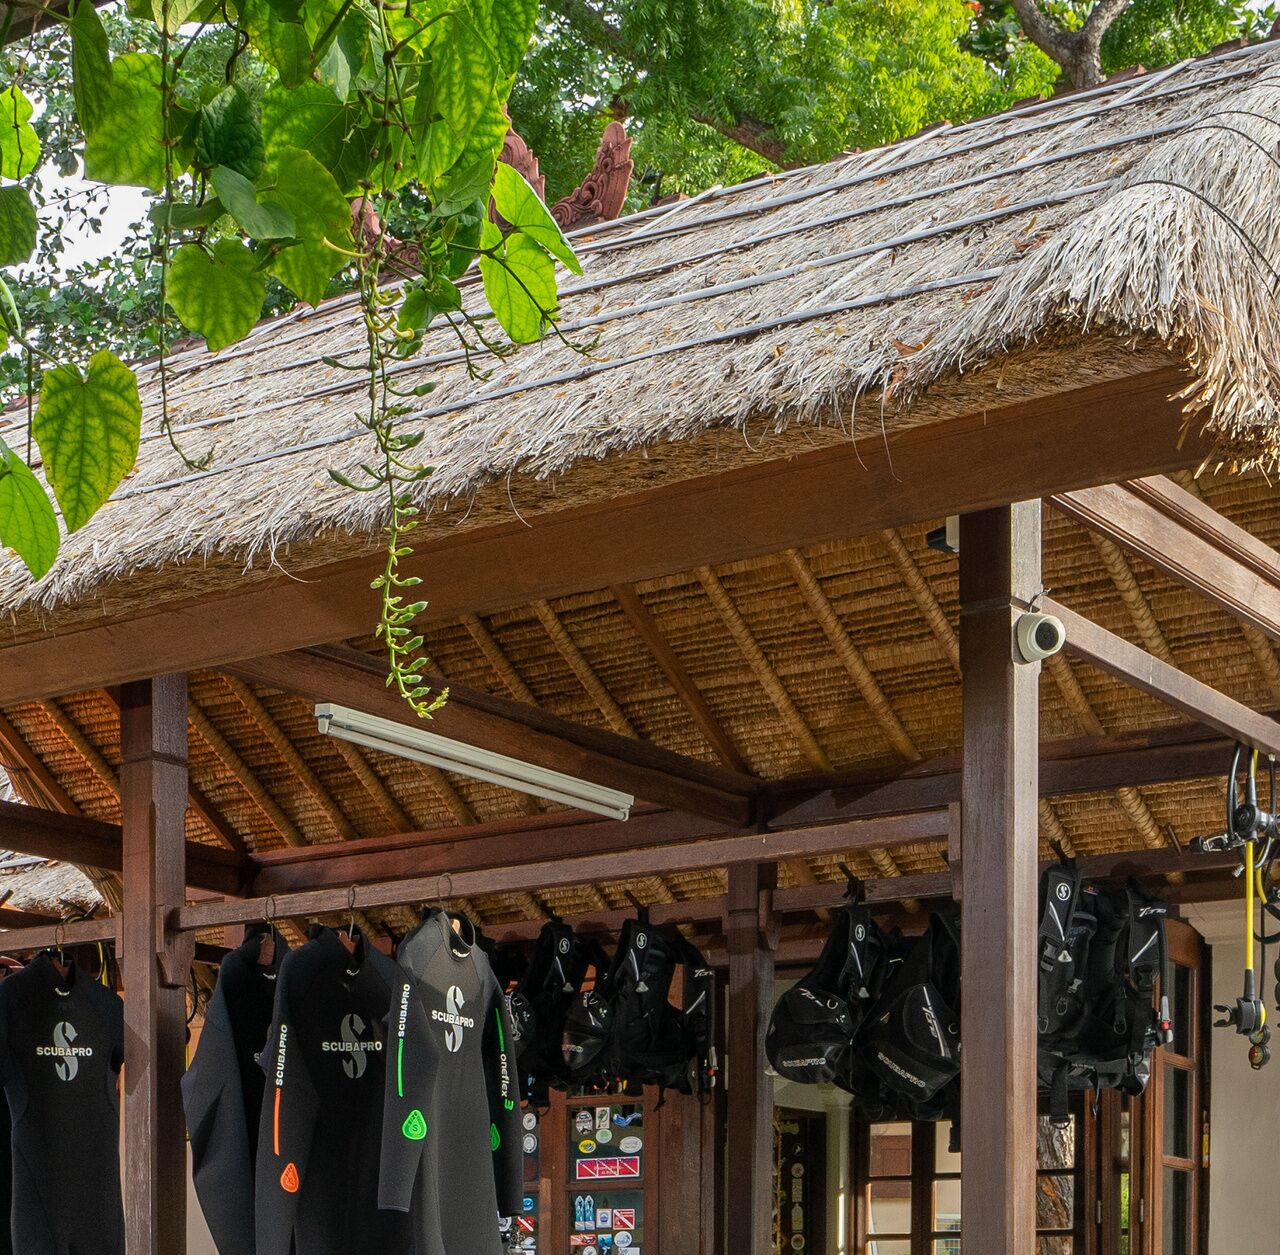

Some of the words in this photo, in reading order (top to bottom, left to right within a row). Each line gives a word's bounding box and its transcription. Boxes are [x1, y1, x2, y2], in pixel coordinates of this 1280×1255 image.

[398, 984, 411, 1037] SCUBAPRO
[431, 1010, 475, 1028] SCUBAPRO
[36, 1046, 93, 1057] SCUBAPRO
[276, 1024, 288, 1086] SCUBAPRO
[321, 1041, 383, 1052] SCUBAPRO
[500, 1053, 509, 1098] oneflex
